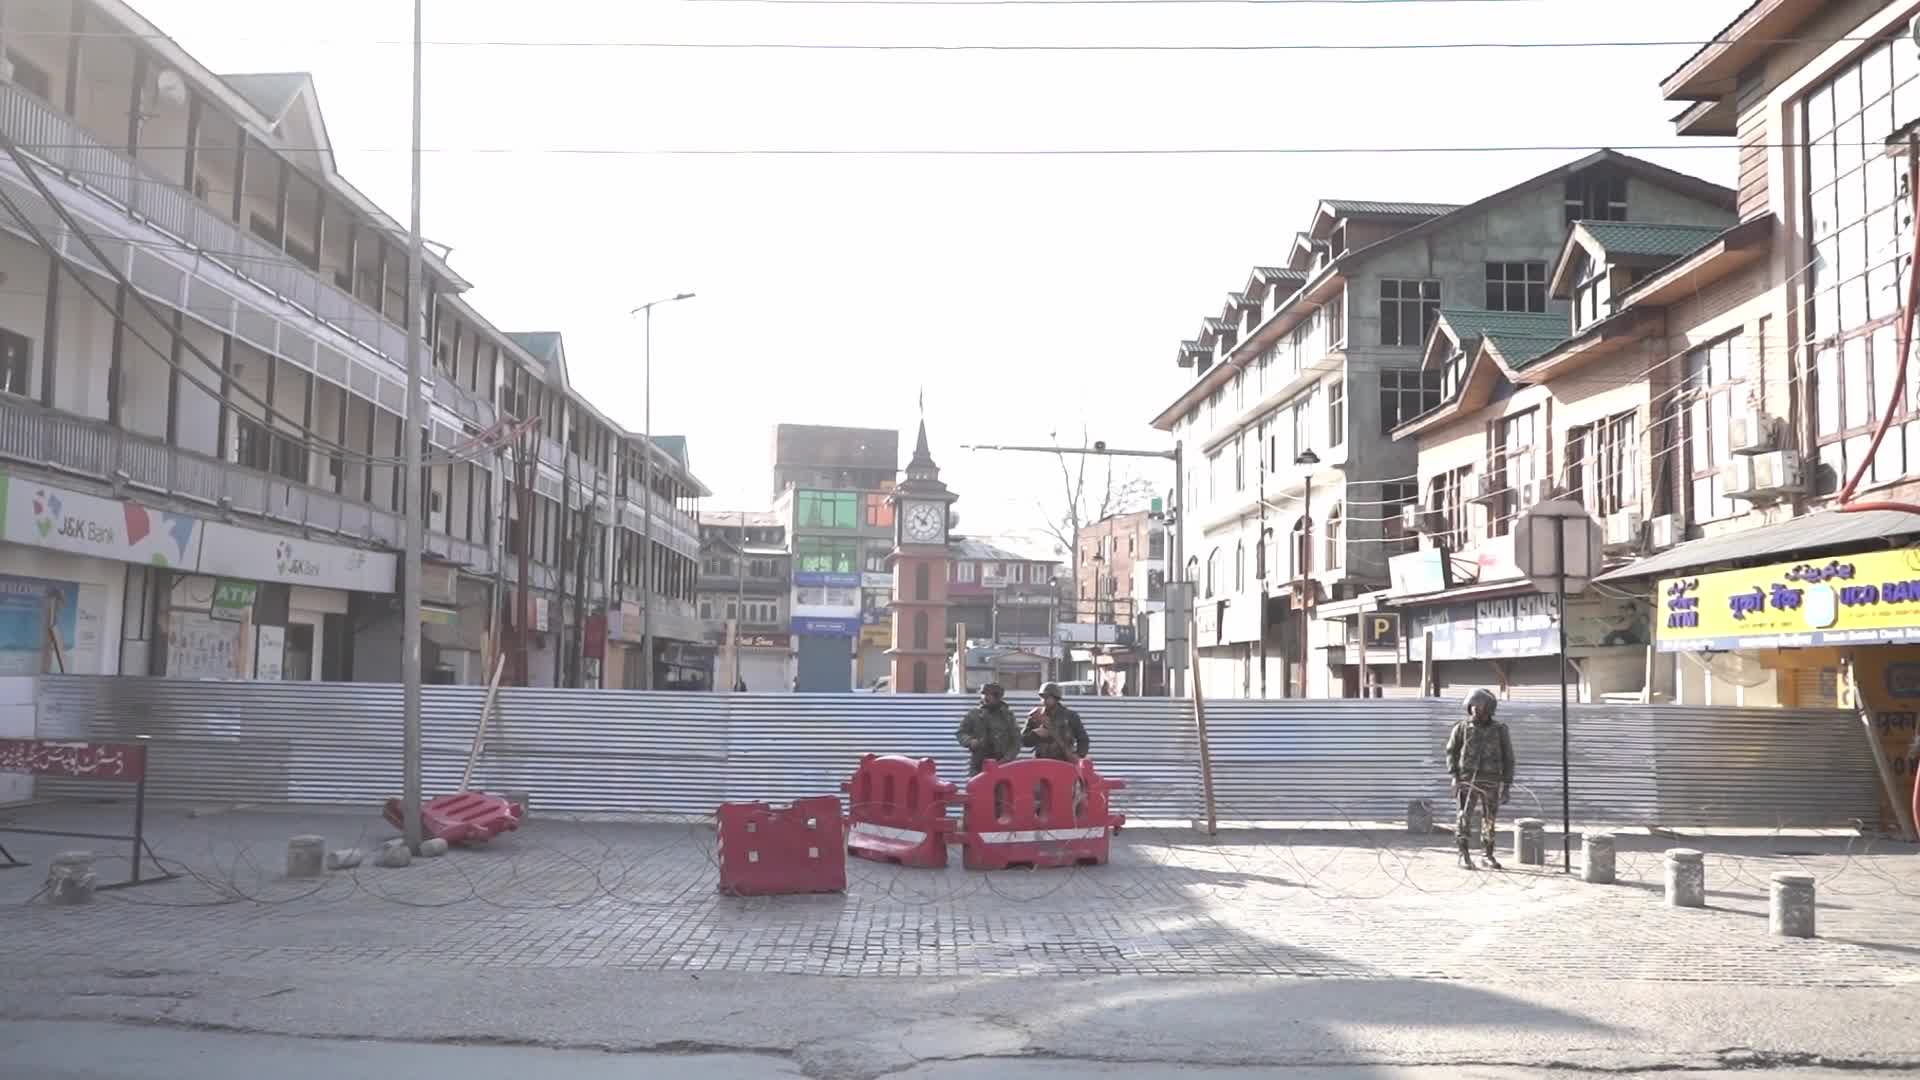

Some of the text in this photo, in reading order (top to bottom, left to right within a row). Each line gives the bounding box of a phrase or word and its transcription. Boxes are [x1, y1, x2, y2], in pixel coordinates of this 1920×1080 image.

[57, 516, 85, 539] J&K
[1374, 618, 1390, 640] P
[1667, 611, 1699, 628] ATM
